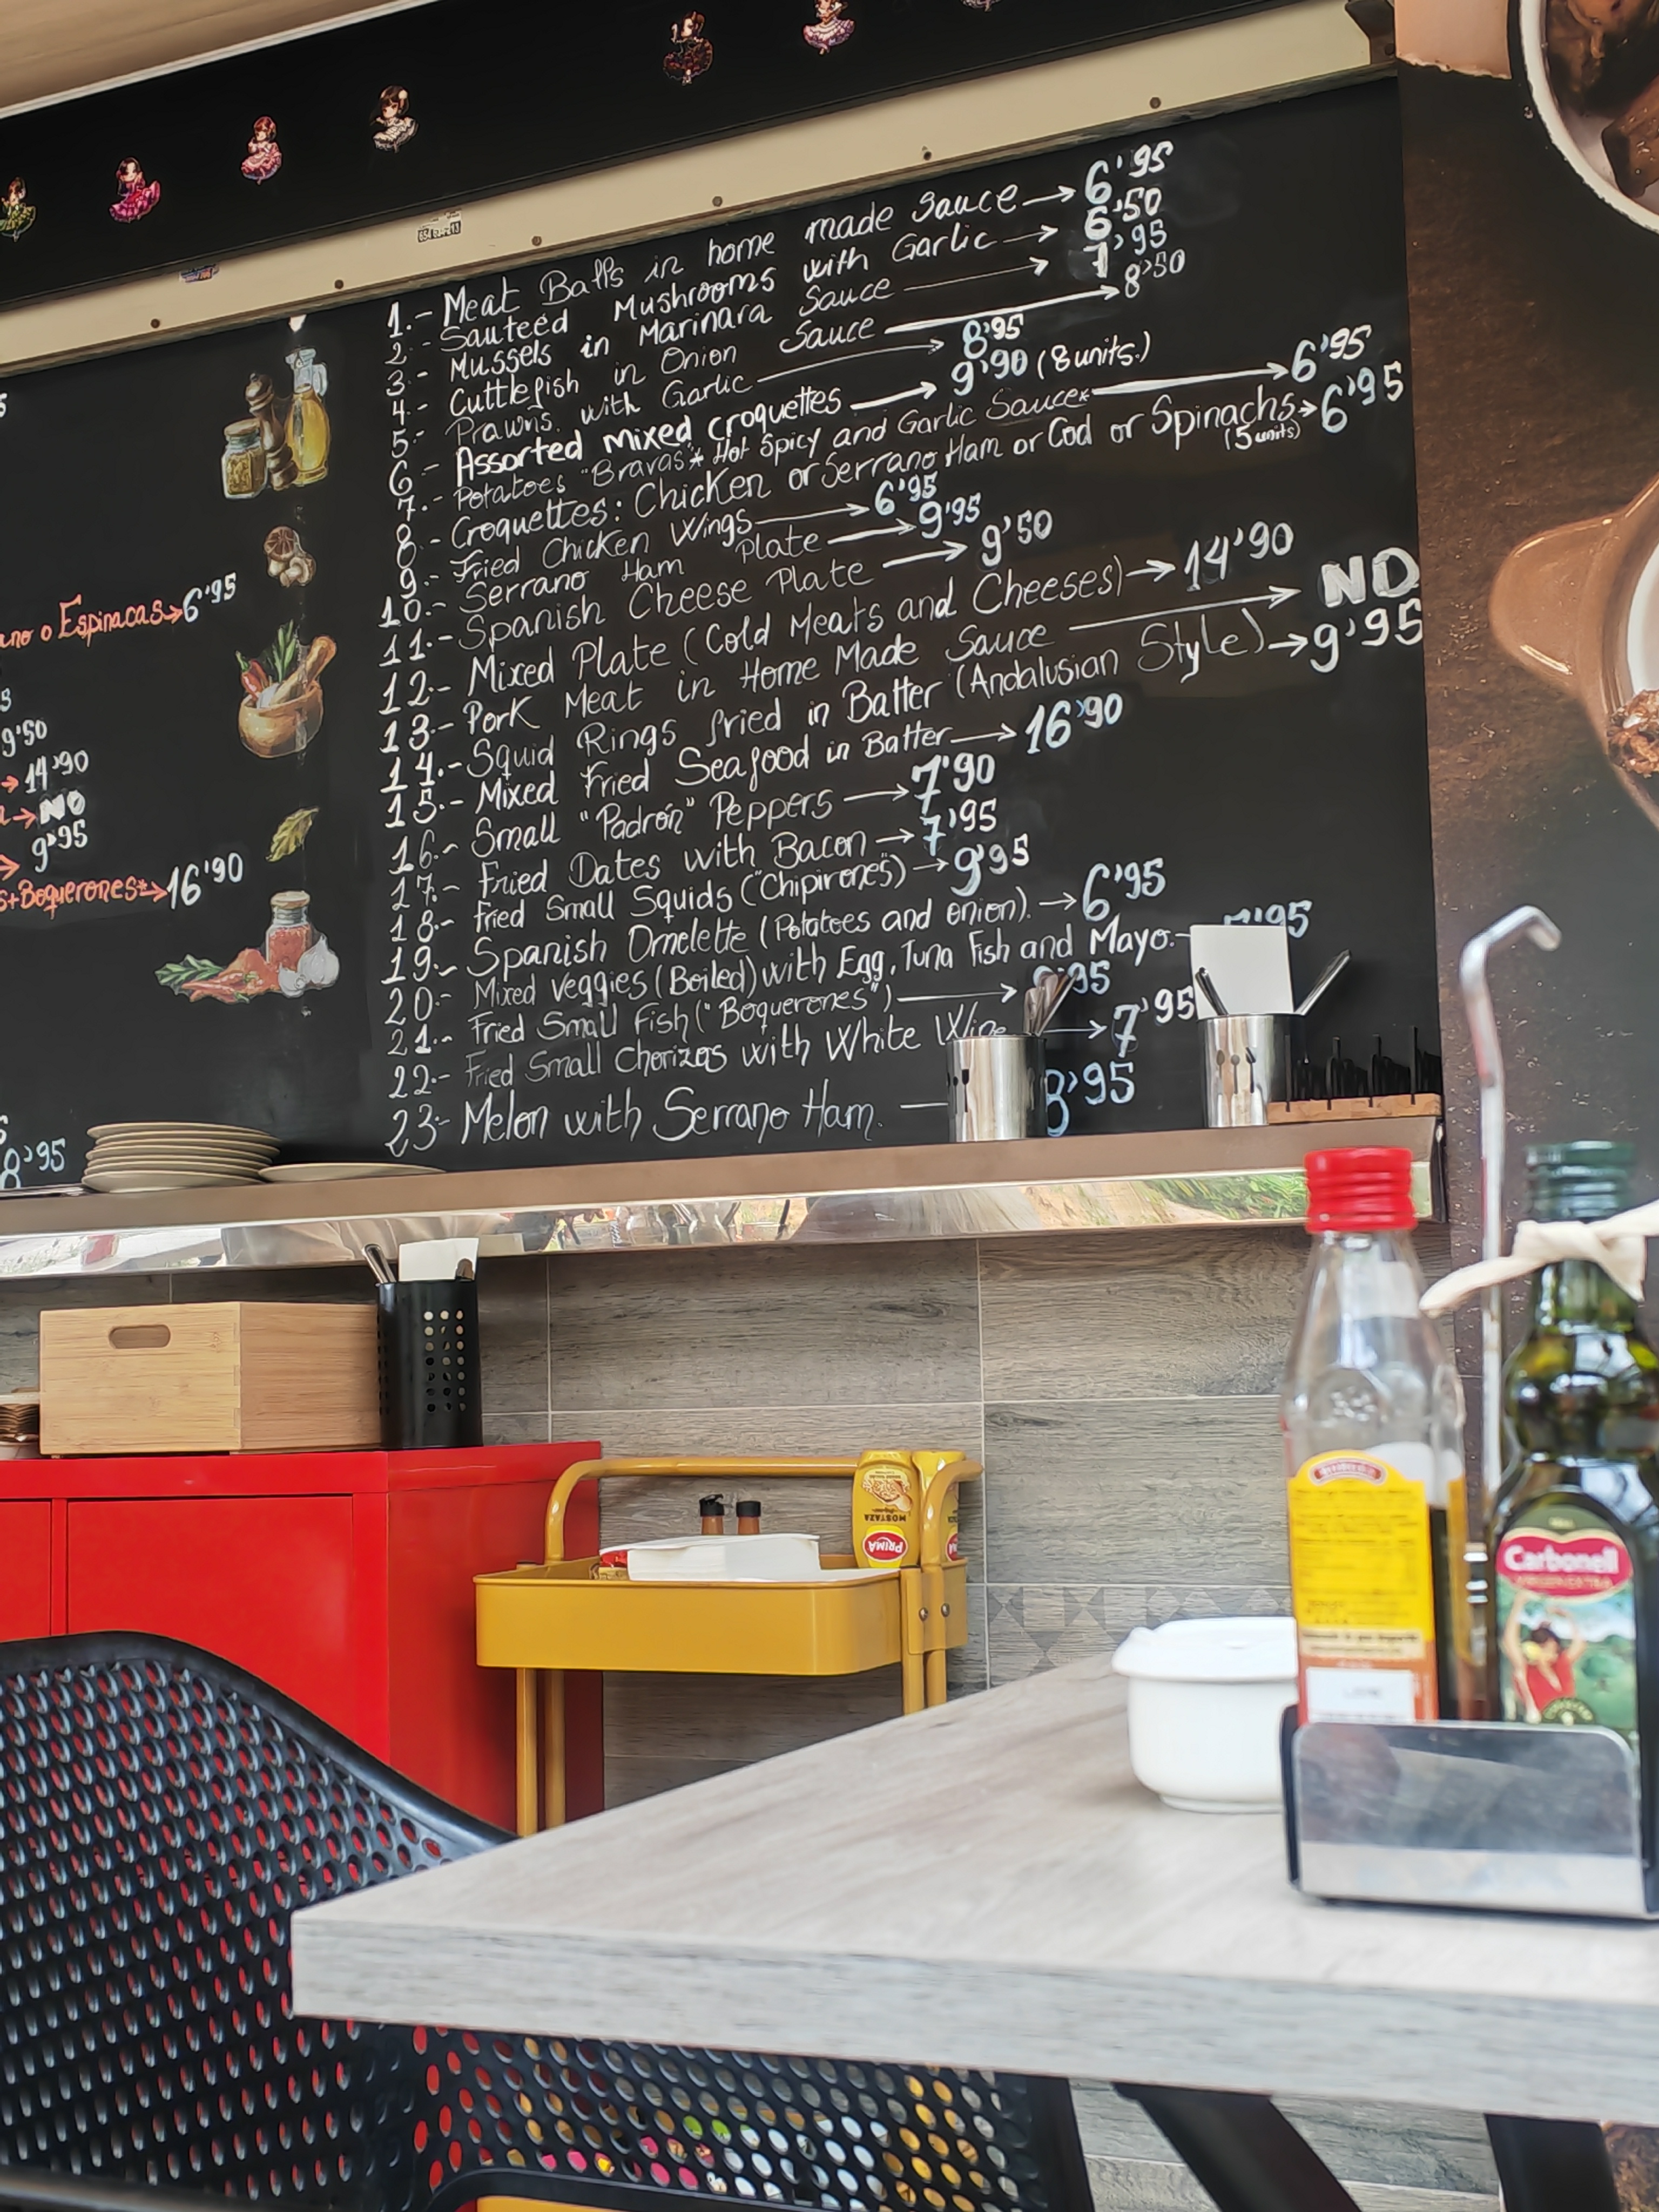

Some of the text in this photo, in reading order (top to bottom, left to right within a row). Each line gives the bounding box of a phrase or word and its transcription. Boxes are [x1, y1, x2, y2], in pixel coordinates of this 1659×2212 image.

[443, 276, 520, 327] Meat
[539, 257, 624, 305] Balls
[644, 256, 684, 282] in
[708, 232, 774, 267] home
[804, 201, 894, 244] made
[912, 184, 1018, 222] Sauce
[612, 267, 778, 323] Mushrooms
[803, 247, 868, 283] with
[892, 222, 997, 262] Garlic
[450, 339, 552, 382] Mussels
[580, 334, 609, 359] in
[639, 304, 773, 346] Marinara
[799, 278, 893, 317] Sauce
[450, 368, 579, 417] Cuttlefish
[614, 363, 646, 386] in
[660, 346, 737, 374] Onion
[779, 318, 874, 353] Sauce
[581, 391, 641, 425] with
[662, 374, 753, 408] Garlic
[453, 474, 565, 511] Potatoes
[712, 436, 750, 465] Hot
[760, 427, 821, 467] Spicy
[833, 417, 887, 448] and
[898, 402, 976, 434] Garlic
[455, 428, 583, 488] Assorted
[635, 467, 772, 518] Chicken
[788, 462, 820, 490] or
[821, 451, 938, 491] Serrano
[945, 434, 1003, 467] Ham
[1013, 431, 1044, 455] or
[1048, 413, 1092, 448] Cod
[1110, 413, 1144, 443] or
[1151, 384, 1297, 450] Spinachs
[449, 545, 520, 583] Fried
[542, 529, 649, 569] Chicken
[670, 508, 752, 547] Wings
[459, 567, 590, 613] Serrano
[621, 558, 684, 582] Ham
[735, 524, 819, 564] Plate
[58, 594, 165, 647] Espinacas
[458, 594, 606, 653] Spanish
[629, 579, 752, 619] Cheese
[765, 558, 873, 595] Plate
[467, 646, 554, 697] Mixed
[572, 633, 670, 680] Plate
[790, 596, 884, 645] Meats
[897, 576, 957, 622] and
[973, 555, 1122, 615] Cheeses)
[462, 696, 540, 735] Pork
[565, 680, 643, 718] Meat
[678, 670, 716, 703] in
[739, 657, 820, 693] Home
[835, 633, 919, 676] Made
[945, 624, 1056, 662] Sauce
[467, 734, 554, 781] Squid
[576, 719, 676, 757] Rings
[705, 697, 781, 747] fried
[808, 701, 830, 727] in
[842, 675, 943, 724] Batter
[956, 649, 1118, 699] (Andalusian
[475, 770, 559, 814] Mixed
[580, 757, 649, 799] Fried
[675, 733, 810, 792] Seafood
[826, 741, 850, 764] in
[861, 720, 953, 758] Batter
[471, 811, 561, 858] Small
[709, 789, 833, 832] Peppers
[478, 859, 548, 899] Fried
[569, 848, 660, 888] Dates
[771, 831, 866, 869] Bacon
[466, 928, 607, 982] Spanish
[628, 917, 748, 963] Omelette
[760, 908, 871, 949] (Potatoes
[881, 898, 932, 932] and
[473, 899, 525, 933] Fried
[546, 889, 615, 921] Small
[630, 879, 733, 924] Squids
[474, 973, 536, 1009] Mixed
[762, 941, 826, 987] with
[901, 939, 953, 971] Tuna
[968, 927, 1010, 967] Fish
[1020, 923, 1073, 960] and
[465, 1049, 513, 1088] Fried
[526, 1041, 601, 1082] Small
[742, 1023, 811, 1067] with
[826, 1014, 921, 1061] White
[468, 1011, 524, 1044] Fried
[536, 1002, 617, 1040] Small
[634, 1002, 689, 1043] Fish
[461, 1089, 549, 1144] Melon
[564, 1087, 642, 1141] with
[652, 1086, 790, 1144] Serrano
[864, 1514, 907, 1522] MOSTAZA
[867, 1537, 903, 1553] PRIMA
